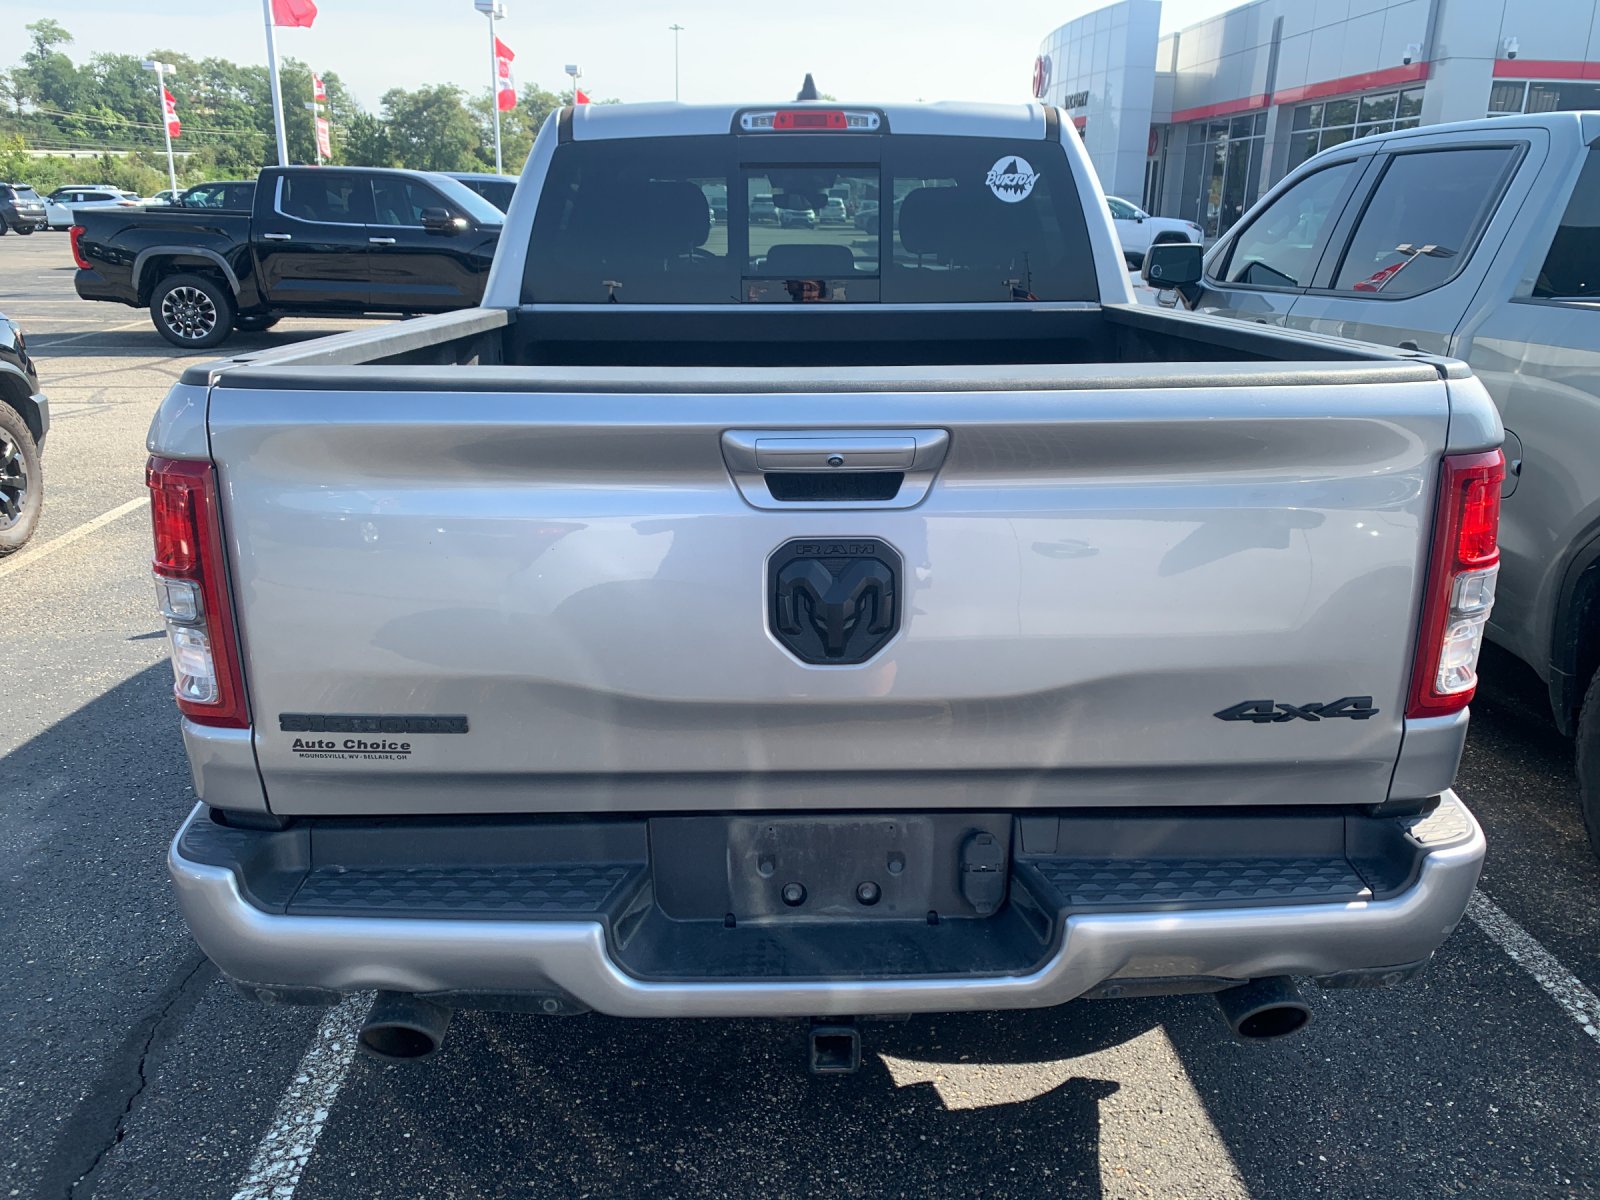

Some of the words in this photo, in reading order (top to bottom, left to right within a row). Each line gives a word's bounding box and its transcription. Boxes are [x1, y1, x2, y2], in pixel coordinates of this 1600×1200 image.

[985, 170, 1040, 186] BURTON
[796, 544, 874, 554] RAM
[292, 738, 336, 750] Auto
[343, 739, 411, 751] Choice
